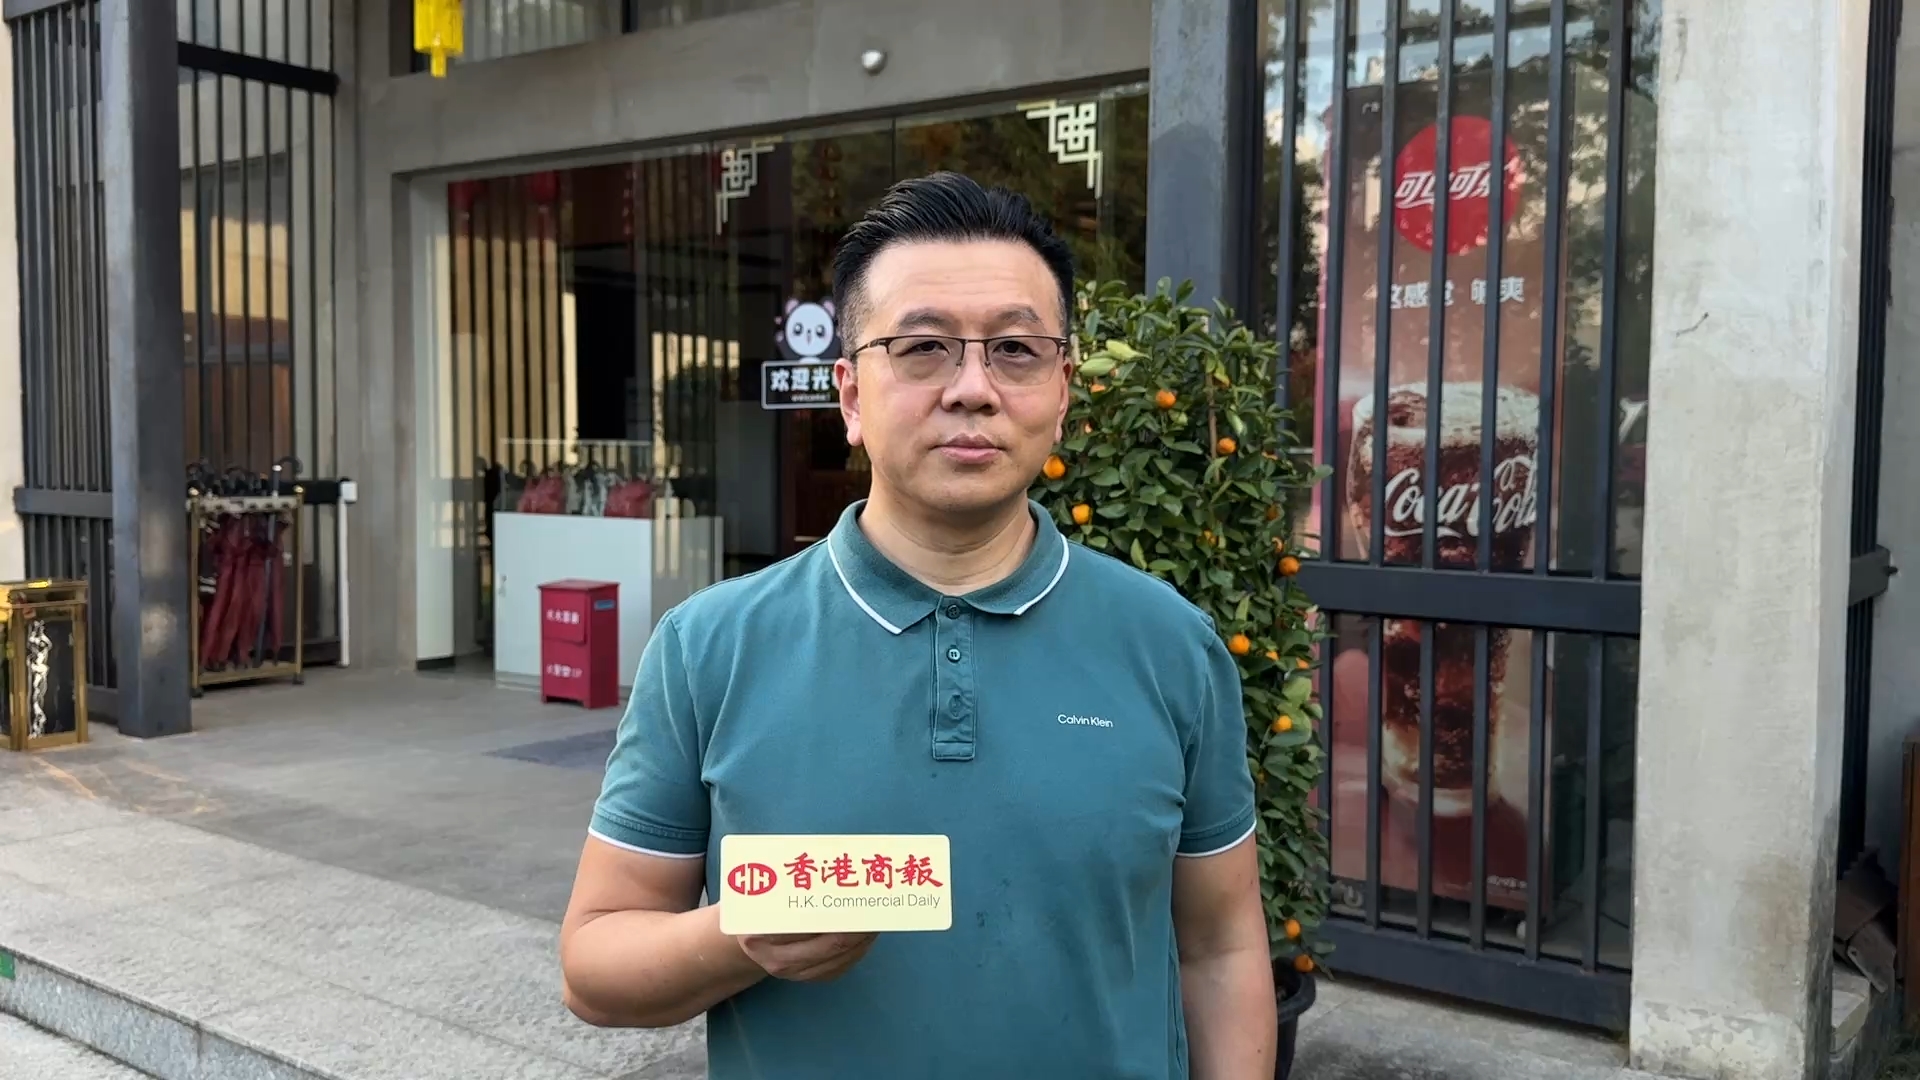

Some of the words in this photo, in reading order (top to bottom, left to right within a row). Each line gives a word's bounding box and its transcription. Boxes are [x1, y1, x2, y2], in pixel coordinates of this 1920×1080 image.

[770, 366, 836, 392] 欢迎光
[1057, 714, 1090, 725] Calvin
[1090, 716, 1114, 727] Klein
[783, 852, 944, 890] 香港商報
[788, 895, 818, 908] H.K.
[822, 894, 905, 908] Commercial
[907, 893, 941, 909] Daily
